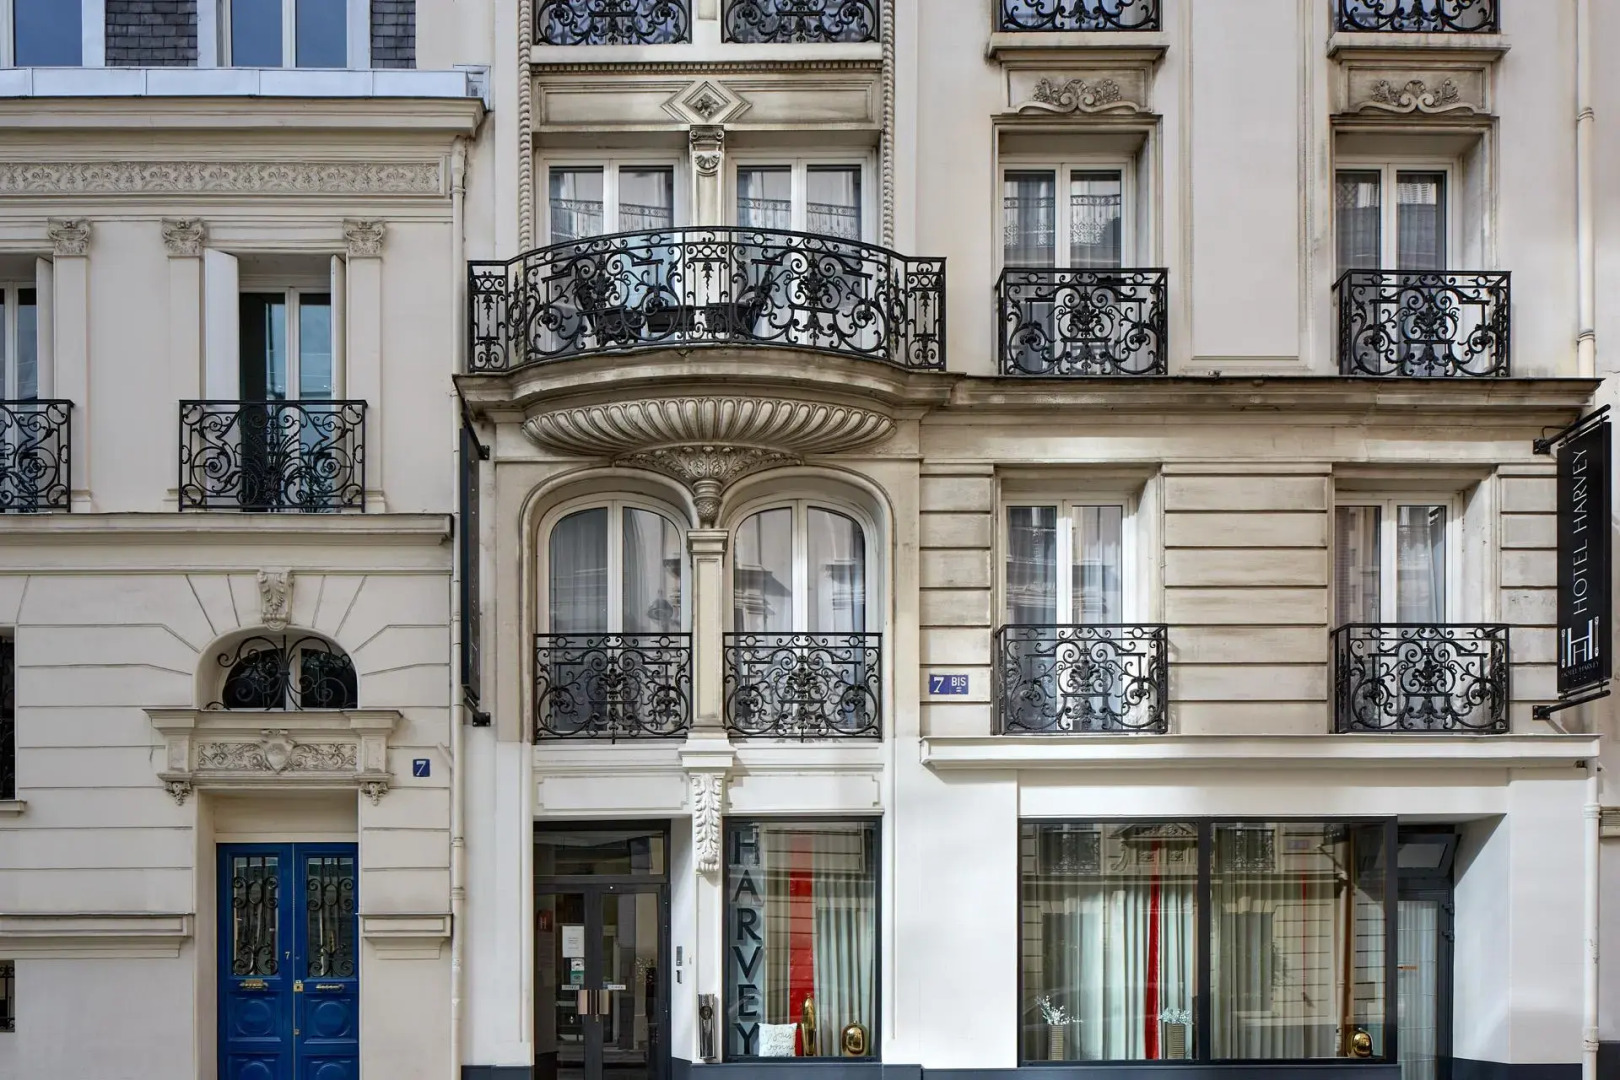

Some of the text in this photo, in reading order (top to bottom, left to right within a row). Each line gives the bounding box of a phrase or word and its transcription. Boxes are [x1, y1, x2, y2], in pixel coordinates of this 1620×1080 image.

[1573, 449, 1588, 616] HOTEL HARVEY
[933, 676, 966, 693] 7 BIS
[416, 760, 427, 776] 7
[731, 829, 762, 1055] HARVEY
[285, 951, 290, 960] 7
